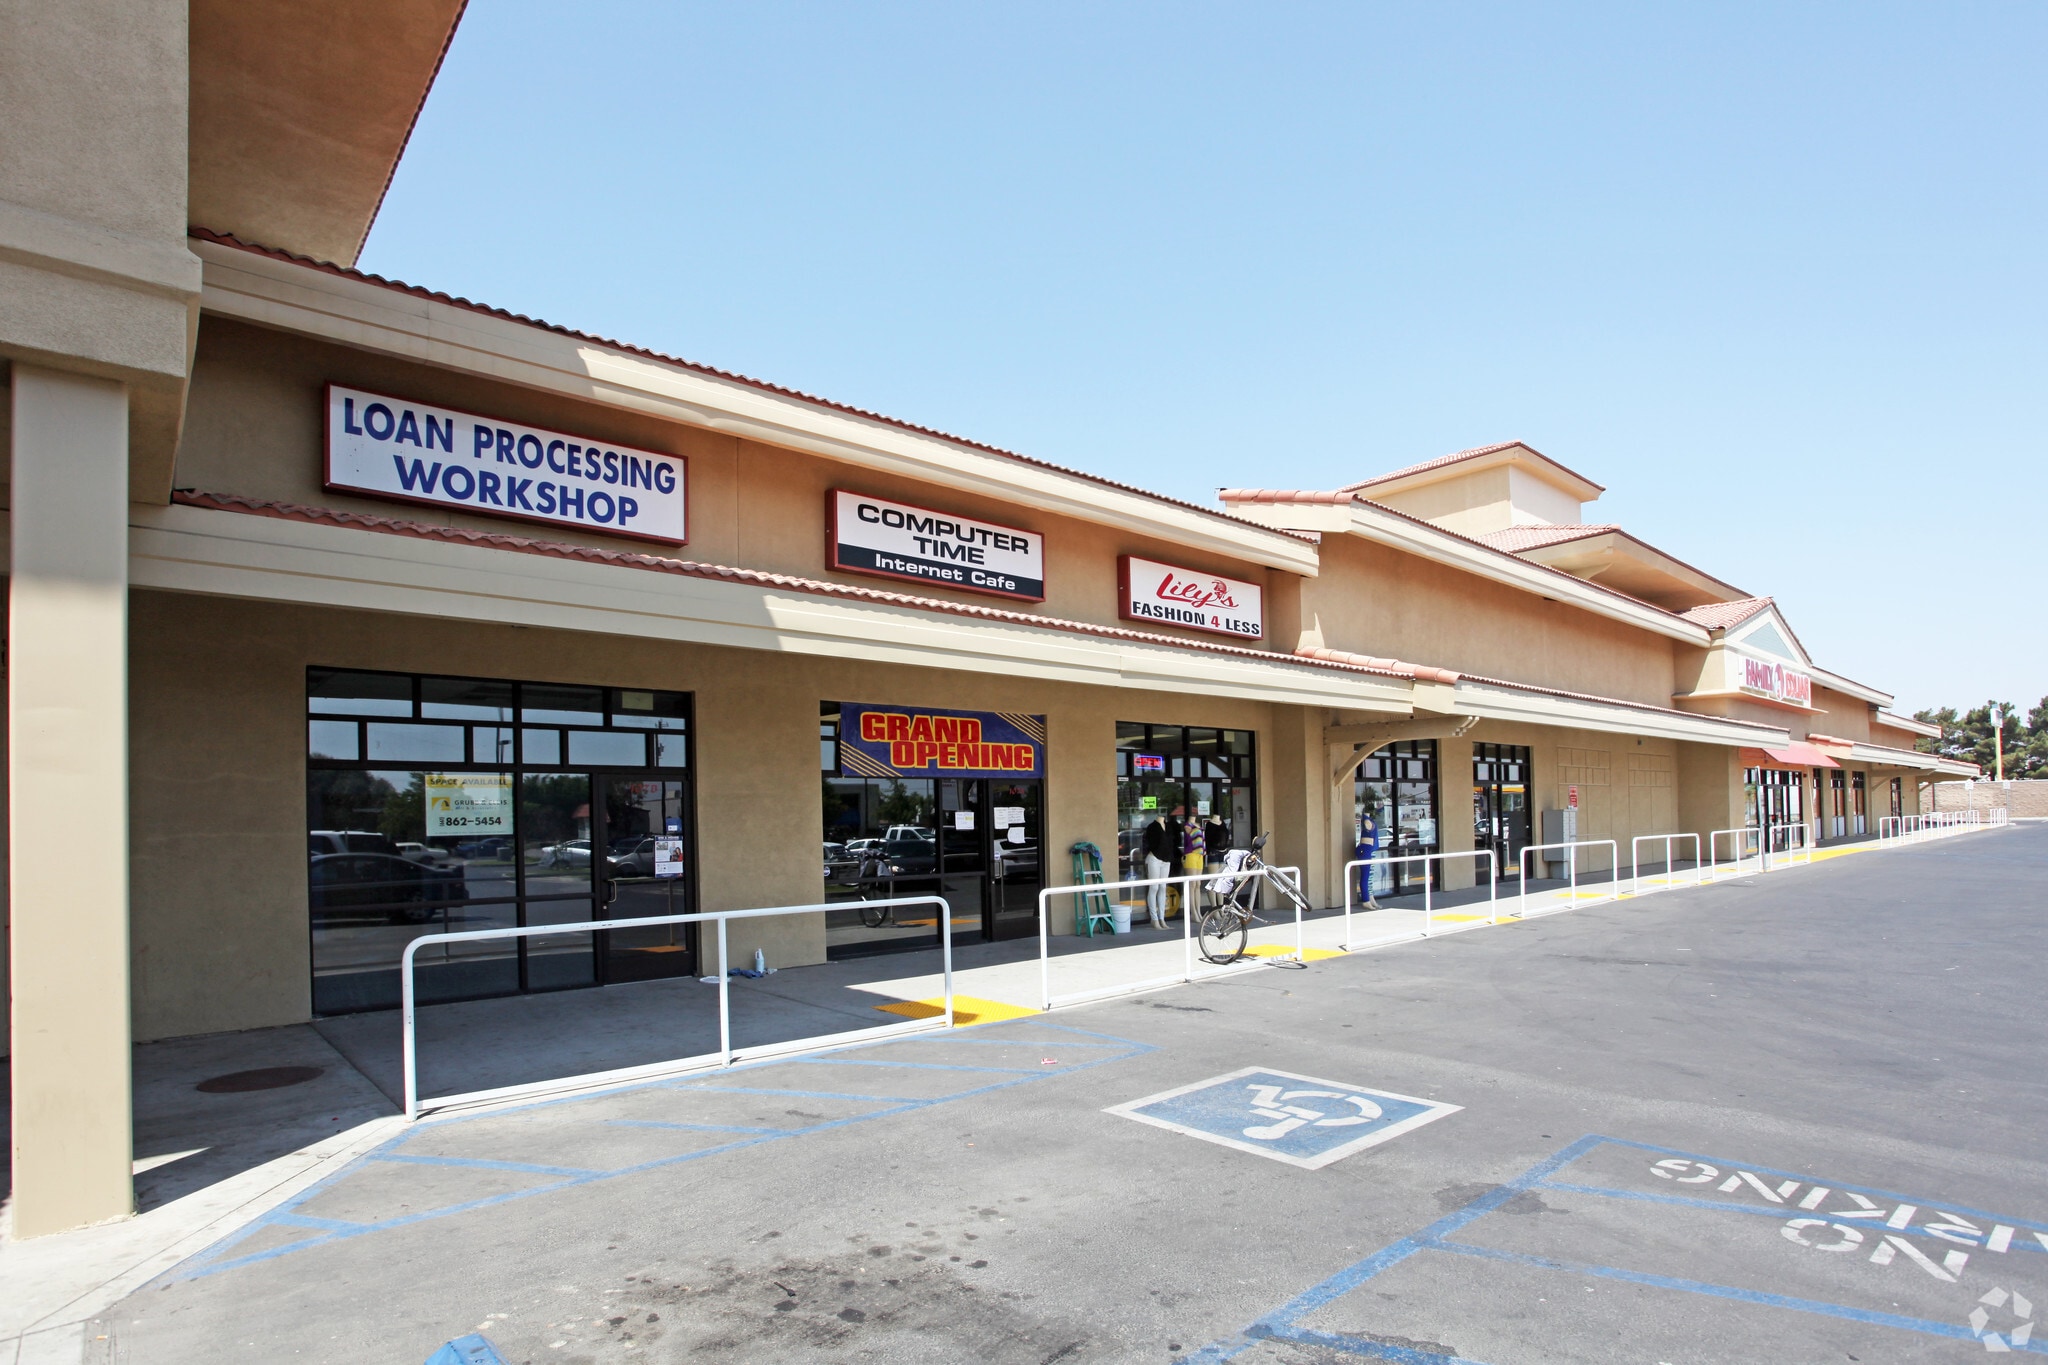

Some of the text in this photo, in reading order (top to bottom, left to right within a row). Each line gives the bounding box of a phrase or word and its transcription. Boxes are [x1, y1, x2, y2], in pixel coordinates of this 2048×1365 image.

[344, 397, 676, 495] LOAN PROCESSING
[393, 455, 639, 526] WORKSHOP
[857, 503, 1029, 555] COMPUTER
[913, 535, 985, 566] TIME
[875, 553, 1016, 591] Internet Cafe
[1132, 601, 1260, 635] FASHION 4 LESS
[861, 712, 982, 743] GRAND
[891, 741, 1034, 771] OPENING
[430, 778, 458, 786] SPACE
[446, 816, 502, 827] 862-5454
[1780, 1218, 1969, 1283] NO
